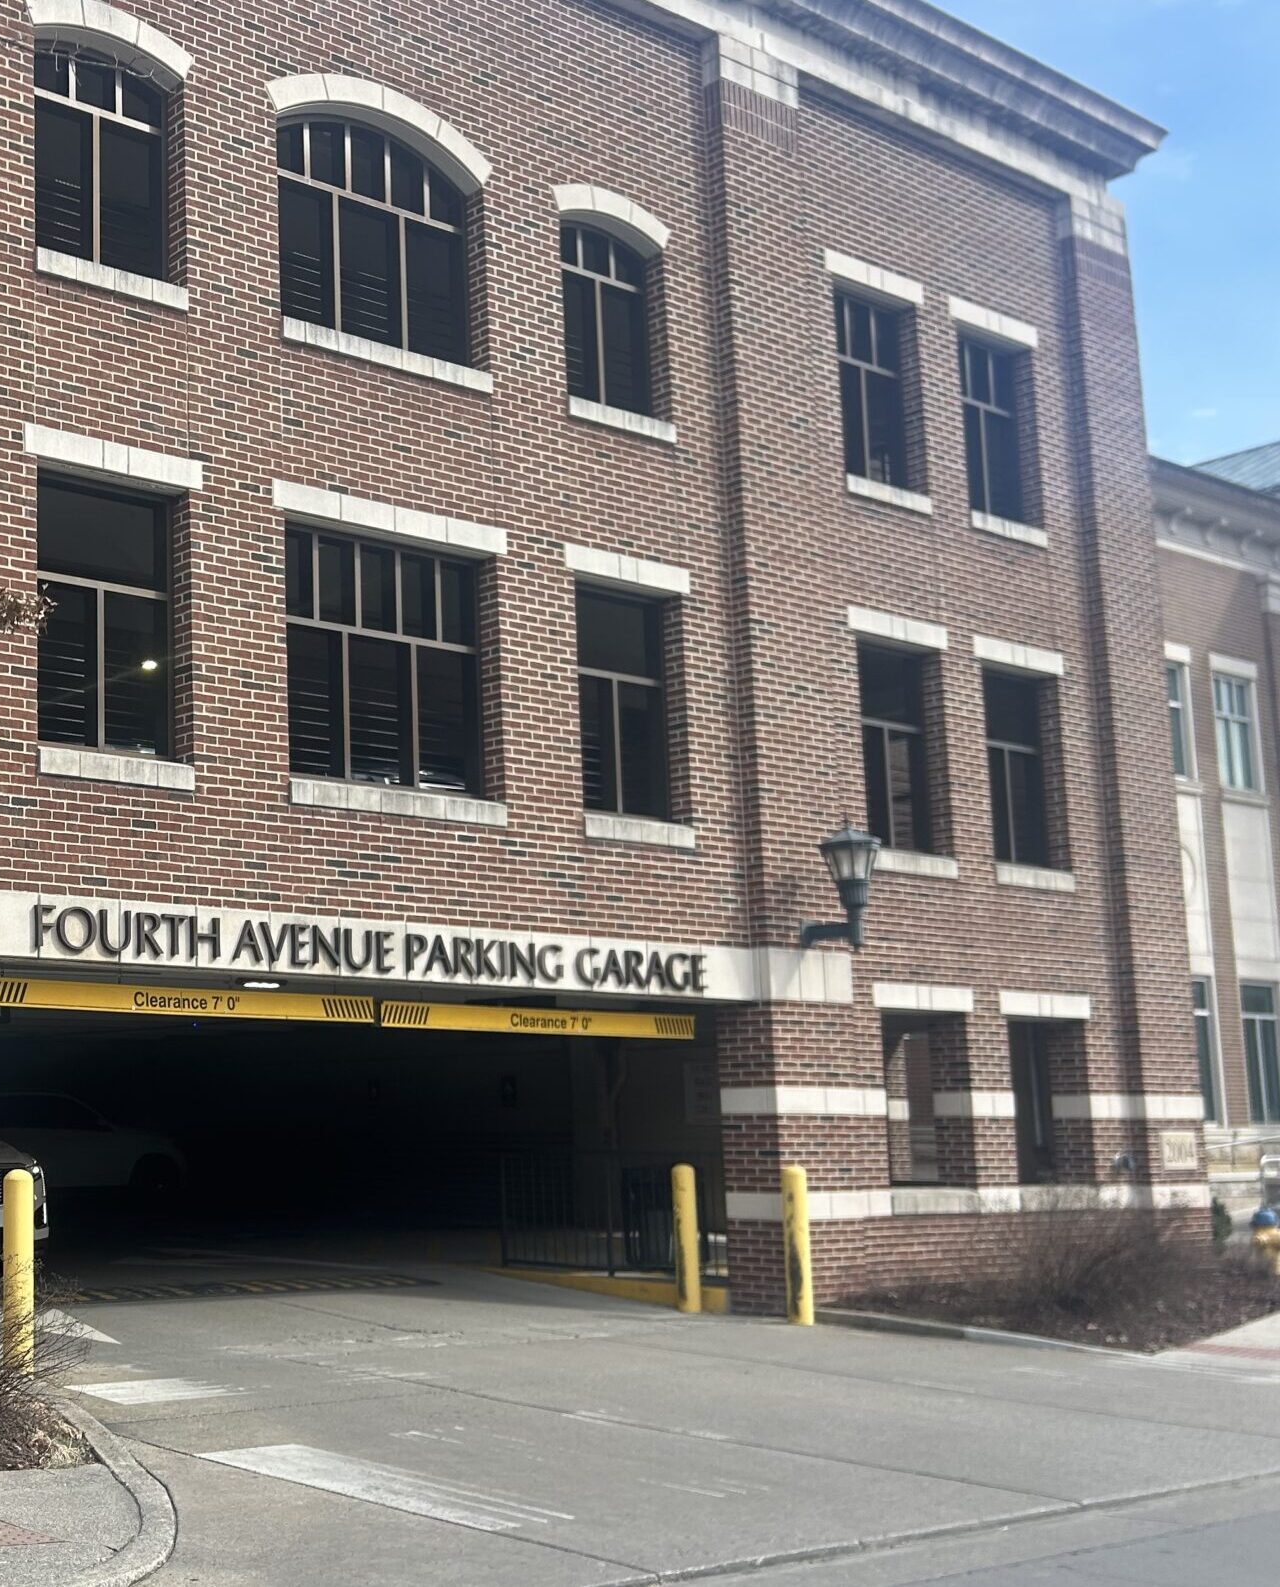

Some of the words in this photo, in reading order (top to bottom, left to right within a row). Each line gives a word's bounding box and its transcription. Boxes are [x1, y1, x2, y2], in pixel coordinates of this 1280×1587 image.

[33, 904, 221, 960] FOURTH
[232, 919, 395, 972] AVENUE
[405, 933, 564, 984] PARKING
[576, 947, 708, 993] GARAGE
[133, 991, 208, 1010] Clearance
[212, 996, 223, 1010] 7'
[510, 1013, 567, 1029] Clearance
